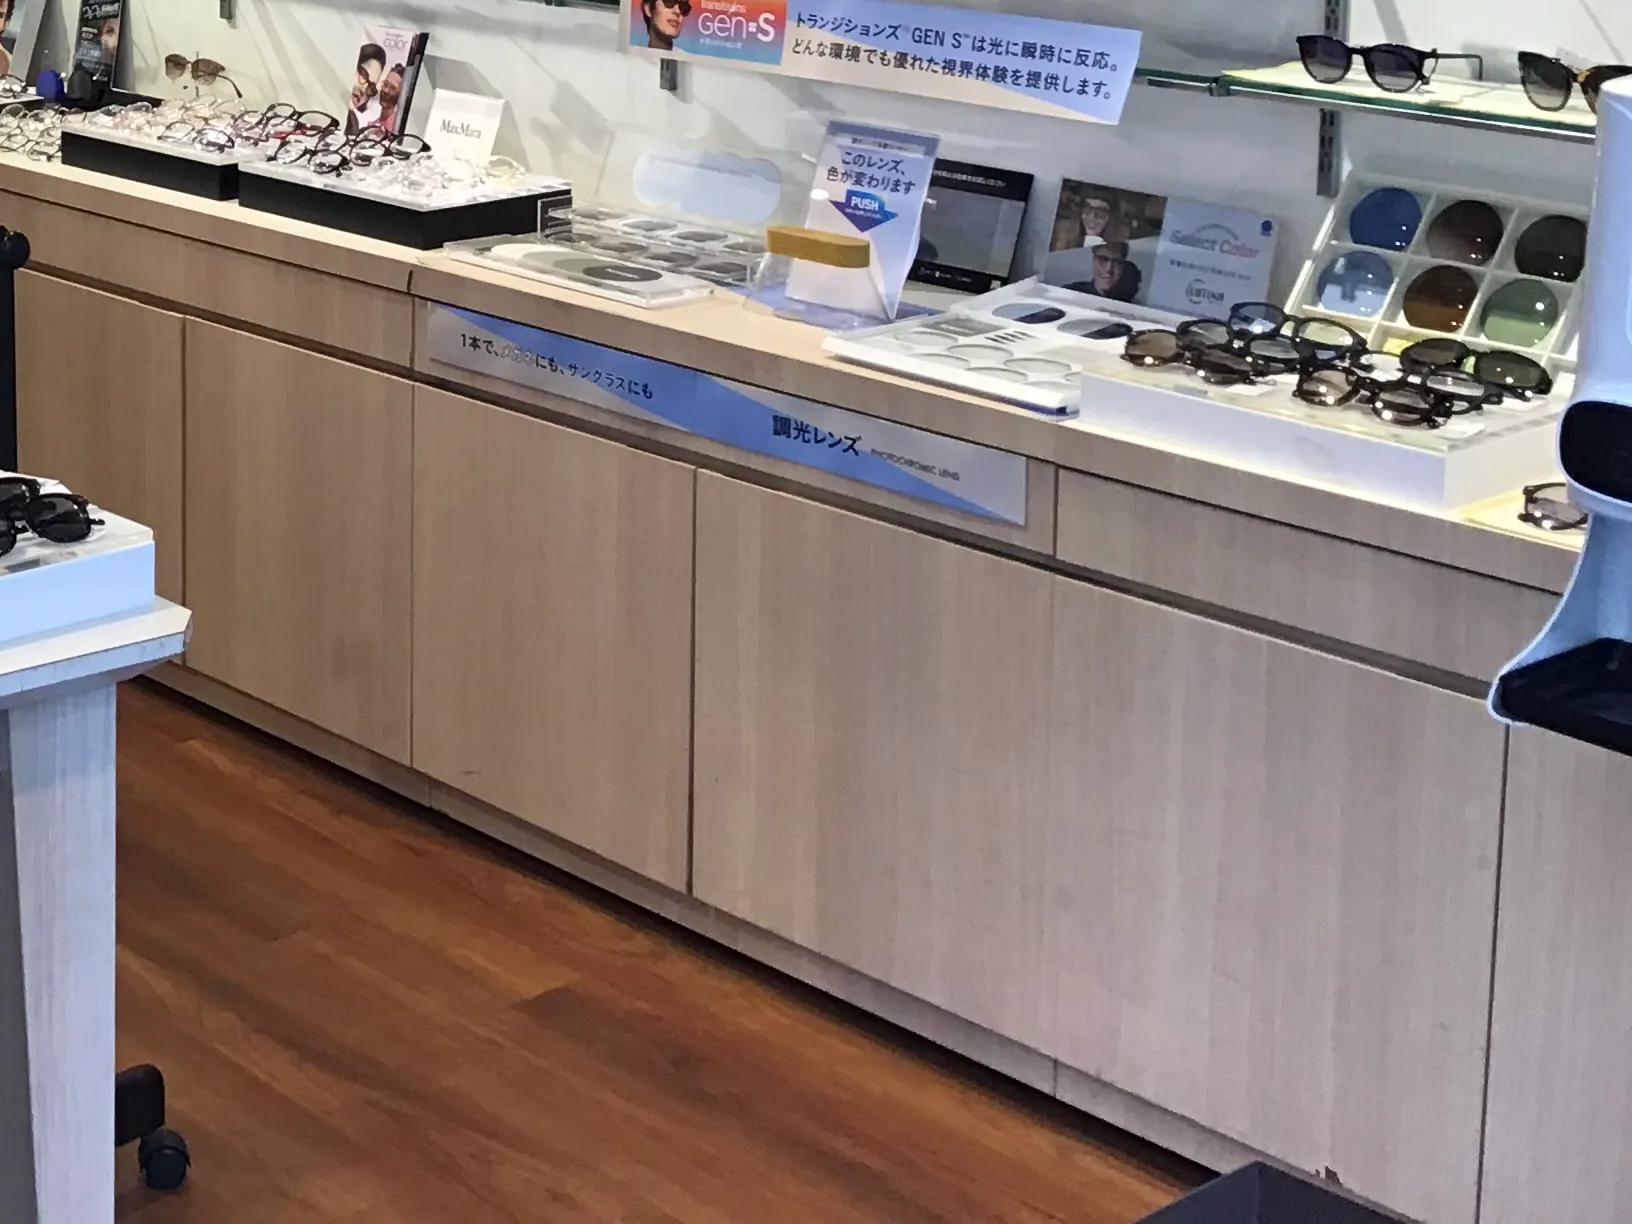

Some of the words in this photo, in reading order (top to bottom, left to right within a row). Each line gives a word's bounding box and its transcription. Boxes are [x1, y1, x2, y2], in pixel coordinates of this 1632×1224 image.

[912, 30, 946, 47] GEN
[841, 151, 906, 176] このレンズ、
[826, 166, 916, 195] 色が変わります
[850, 195, 879, 211] PUSH
[1169, 229, 1218, 251] Select
[1219, 239, 1261, 259] Color
[772, 414, 863, 457] 調光レンズ
